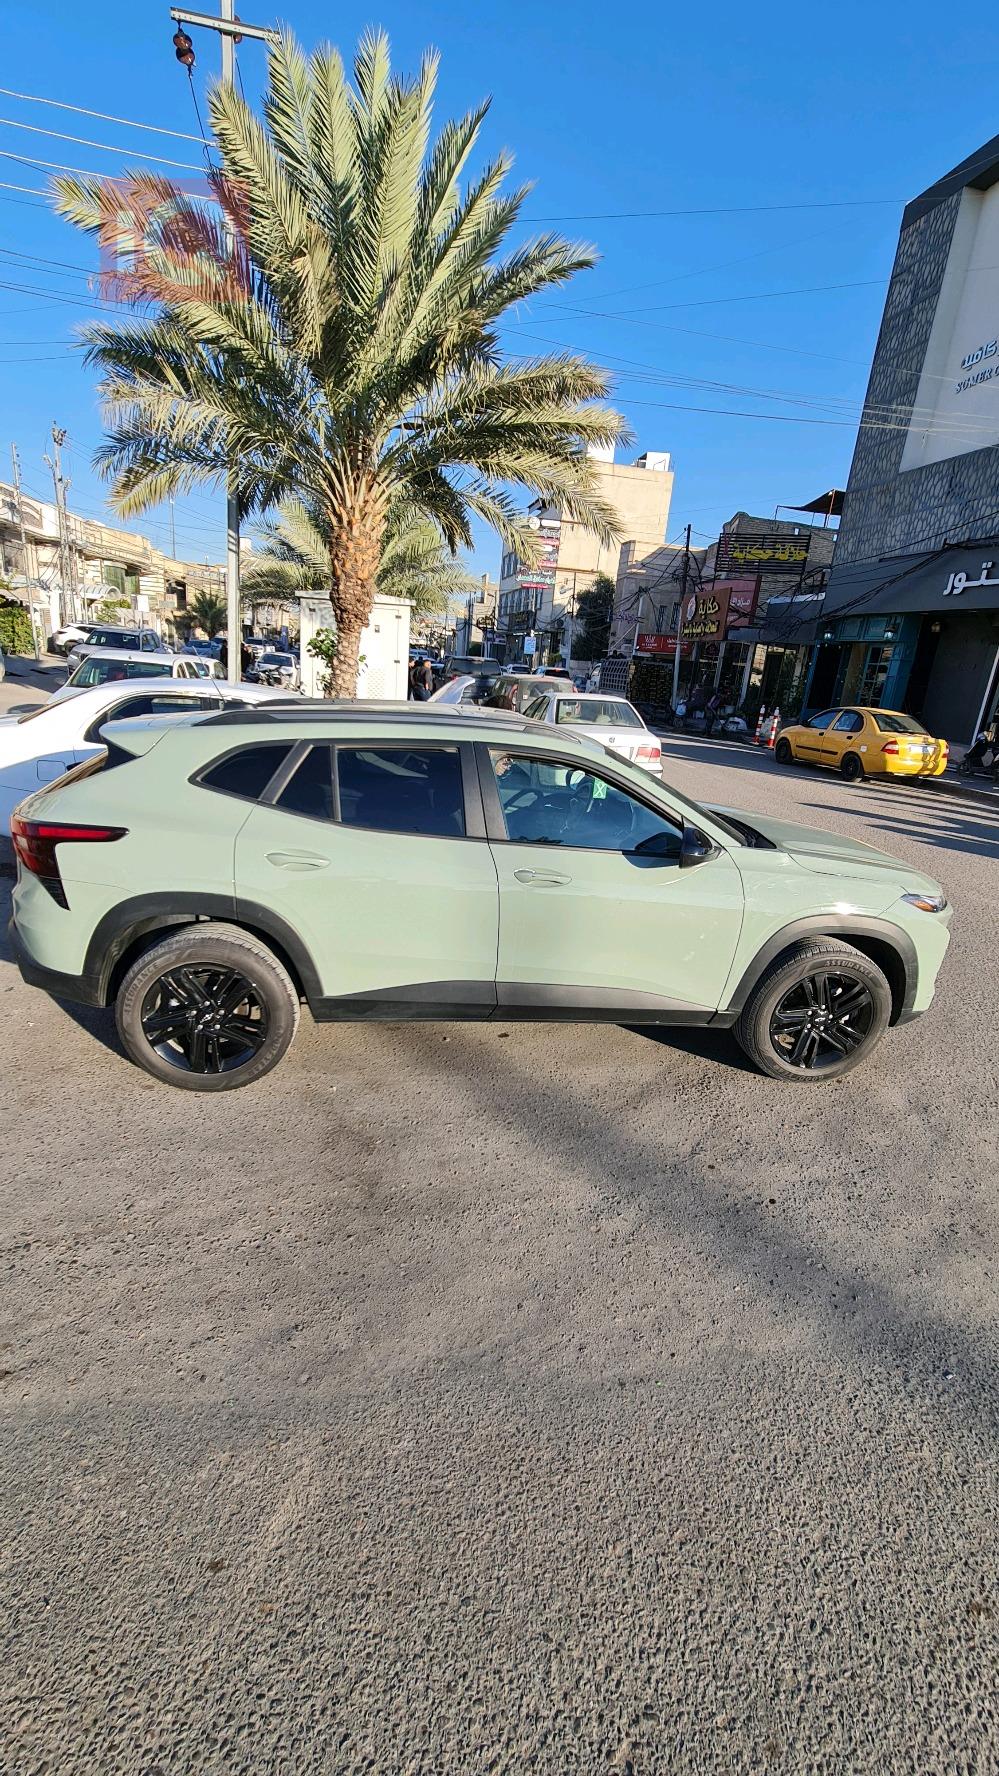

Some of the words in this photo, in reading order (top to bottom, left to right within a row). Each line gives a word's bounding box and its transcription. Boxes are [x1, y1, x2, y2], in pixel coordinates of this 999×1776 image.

[698, 596, 719, 619] حكاية
[824, 960, 874, 979] ASSURANCE
[123, 962, 161, 1014] ASSURANCE
